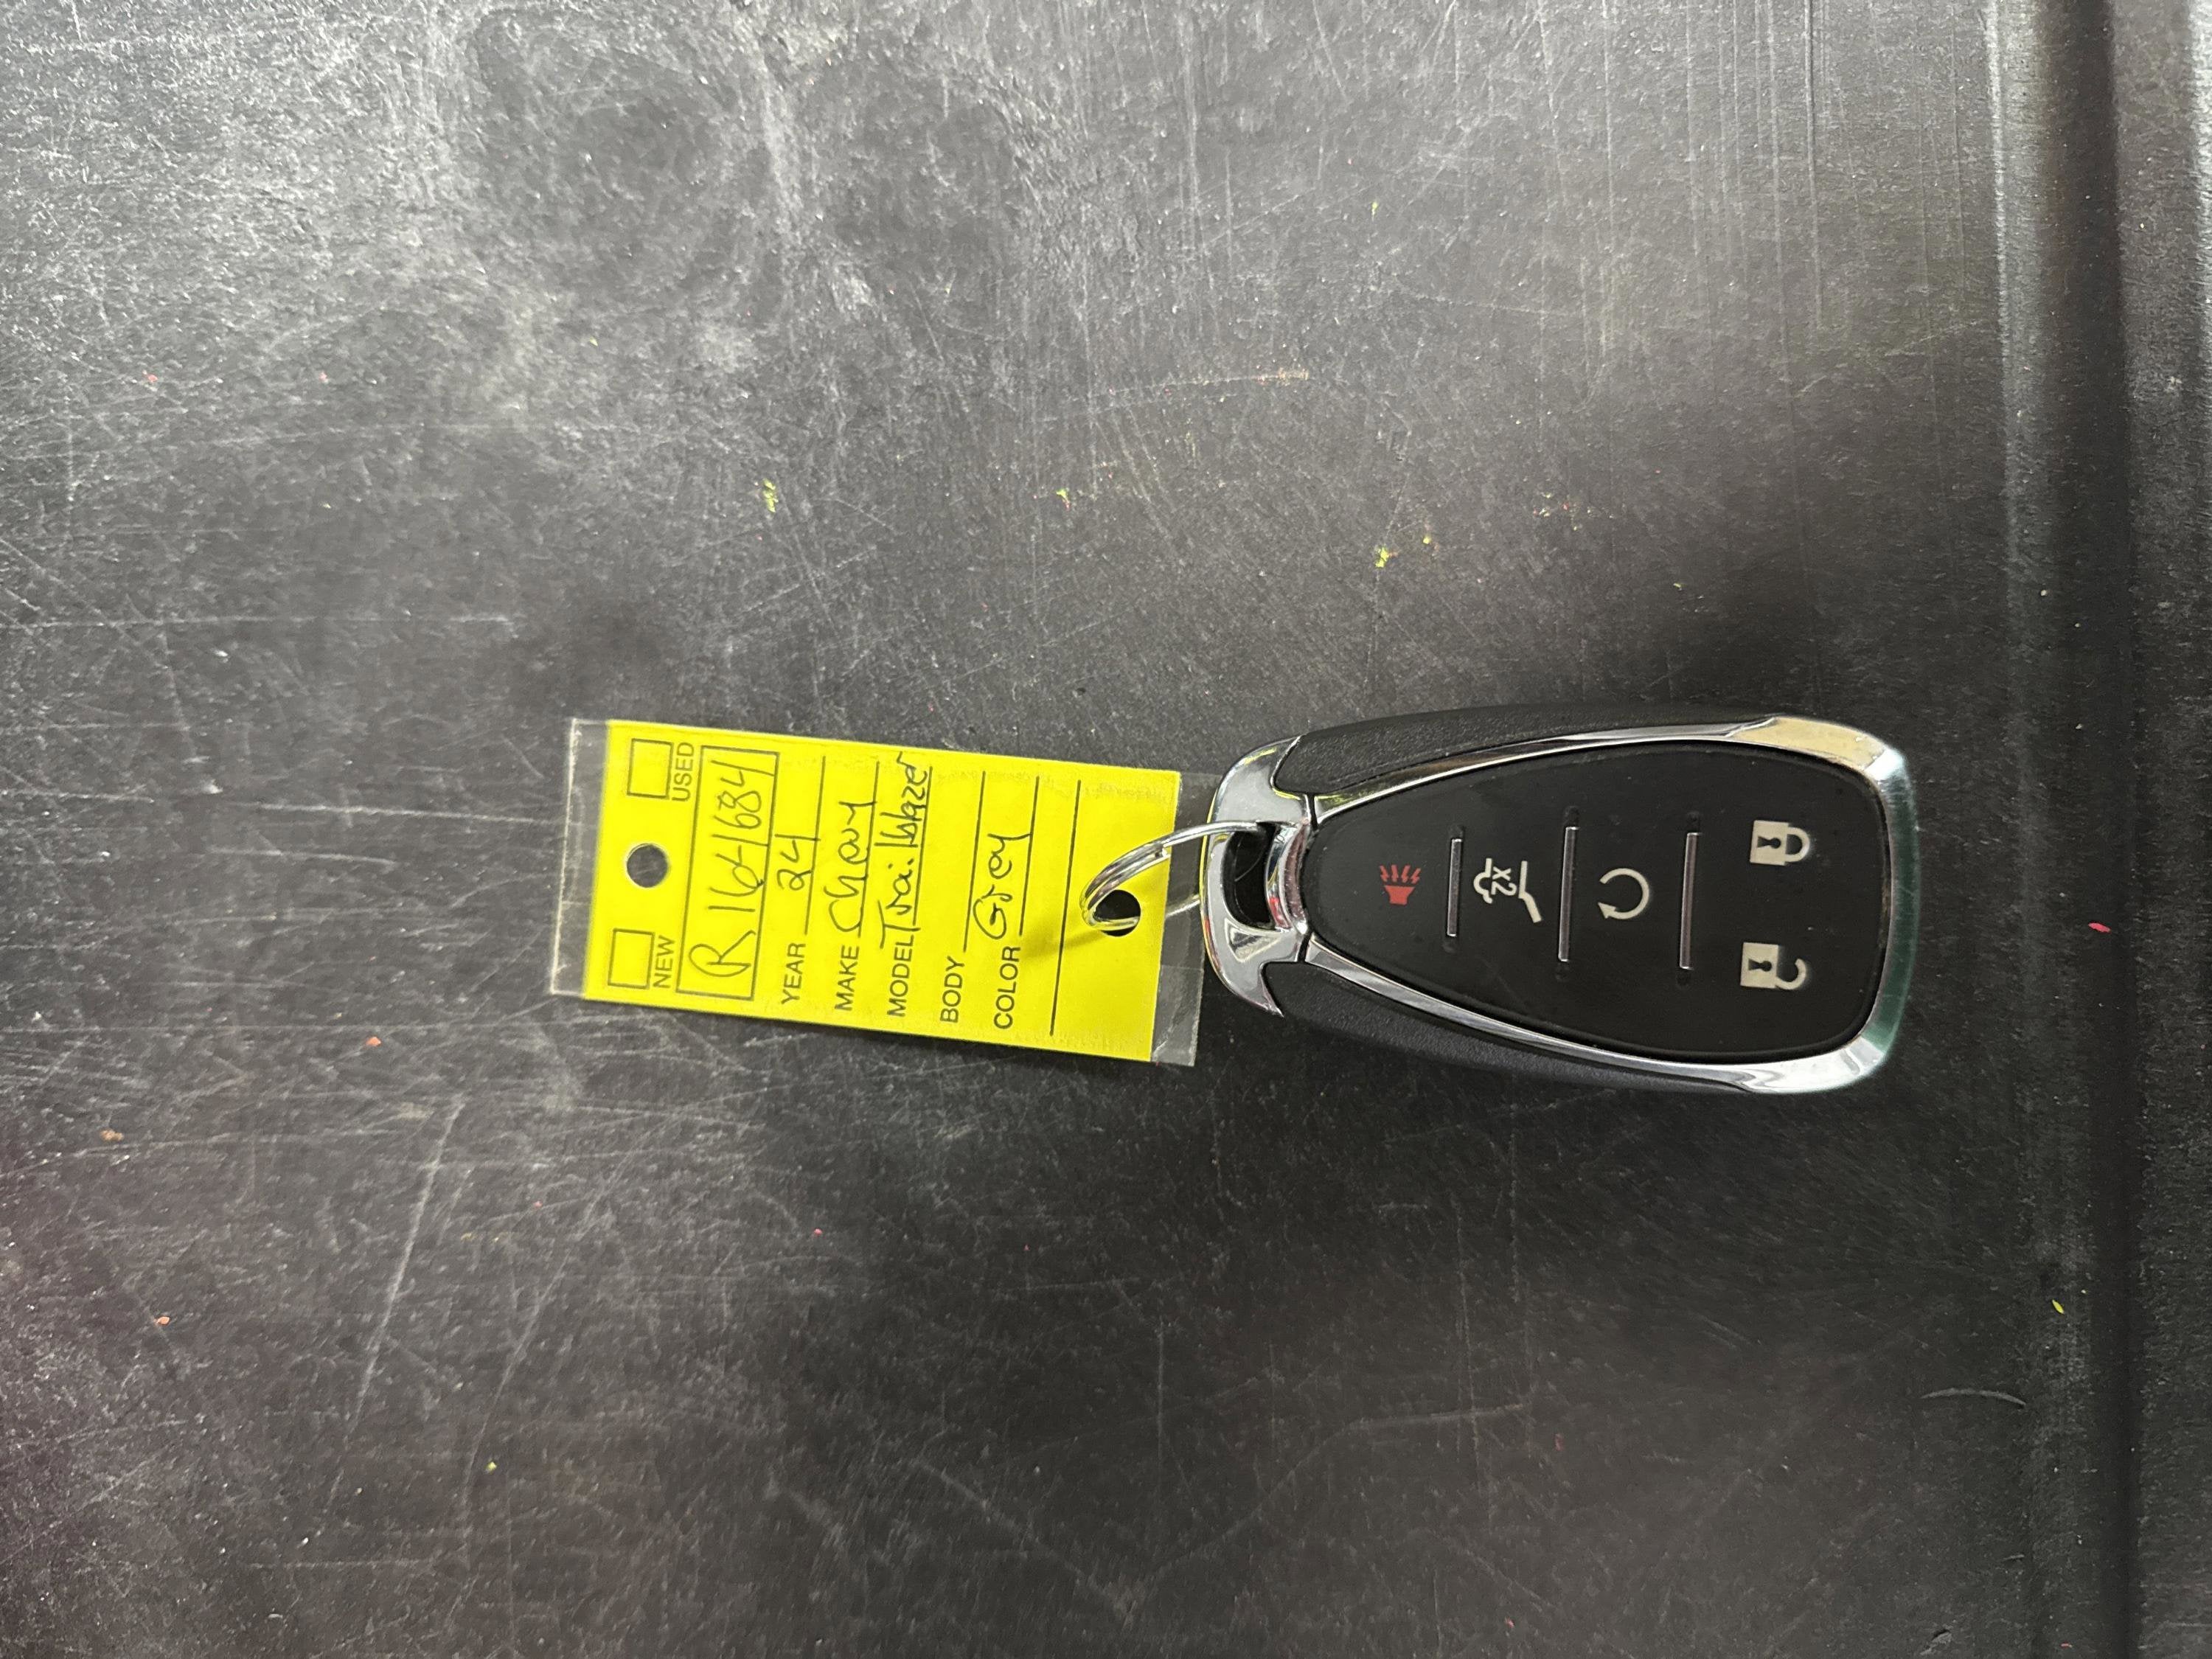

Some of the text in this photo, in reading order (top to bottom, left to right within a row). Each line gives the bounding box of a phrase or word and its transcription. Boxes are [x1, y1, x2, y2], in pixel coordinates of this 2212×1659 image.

[672, 741, 695, 802] USED
[774, 834, 821, 891] 24
[874, 751, 928, 950] Trailblazer
[653, 934, 675, 990] NEW
[782, 942, 806, 1005] YEAR
[834, 946, 860, 1012] MAKE
[887, 934, 914, 1018] MODEL
[940, 956, 965, 1023] BODY
[993, 945, 1021, 1030] COLOR
